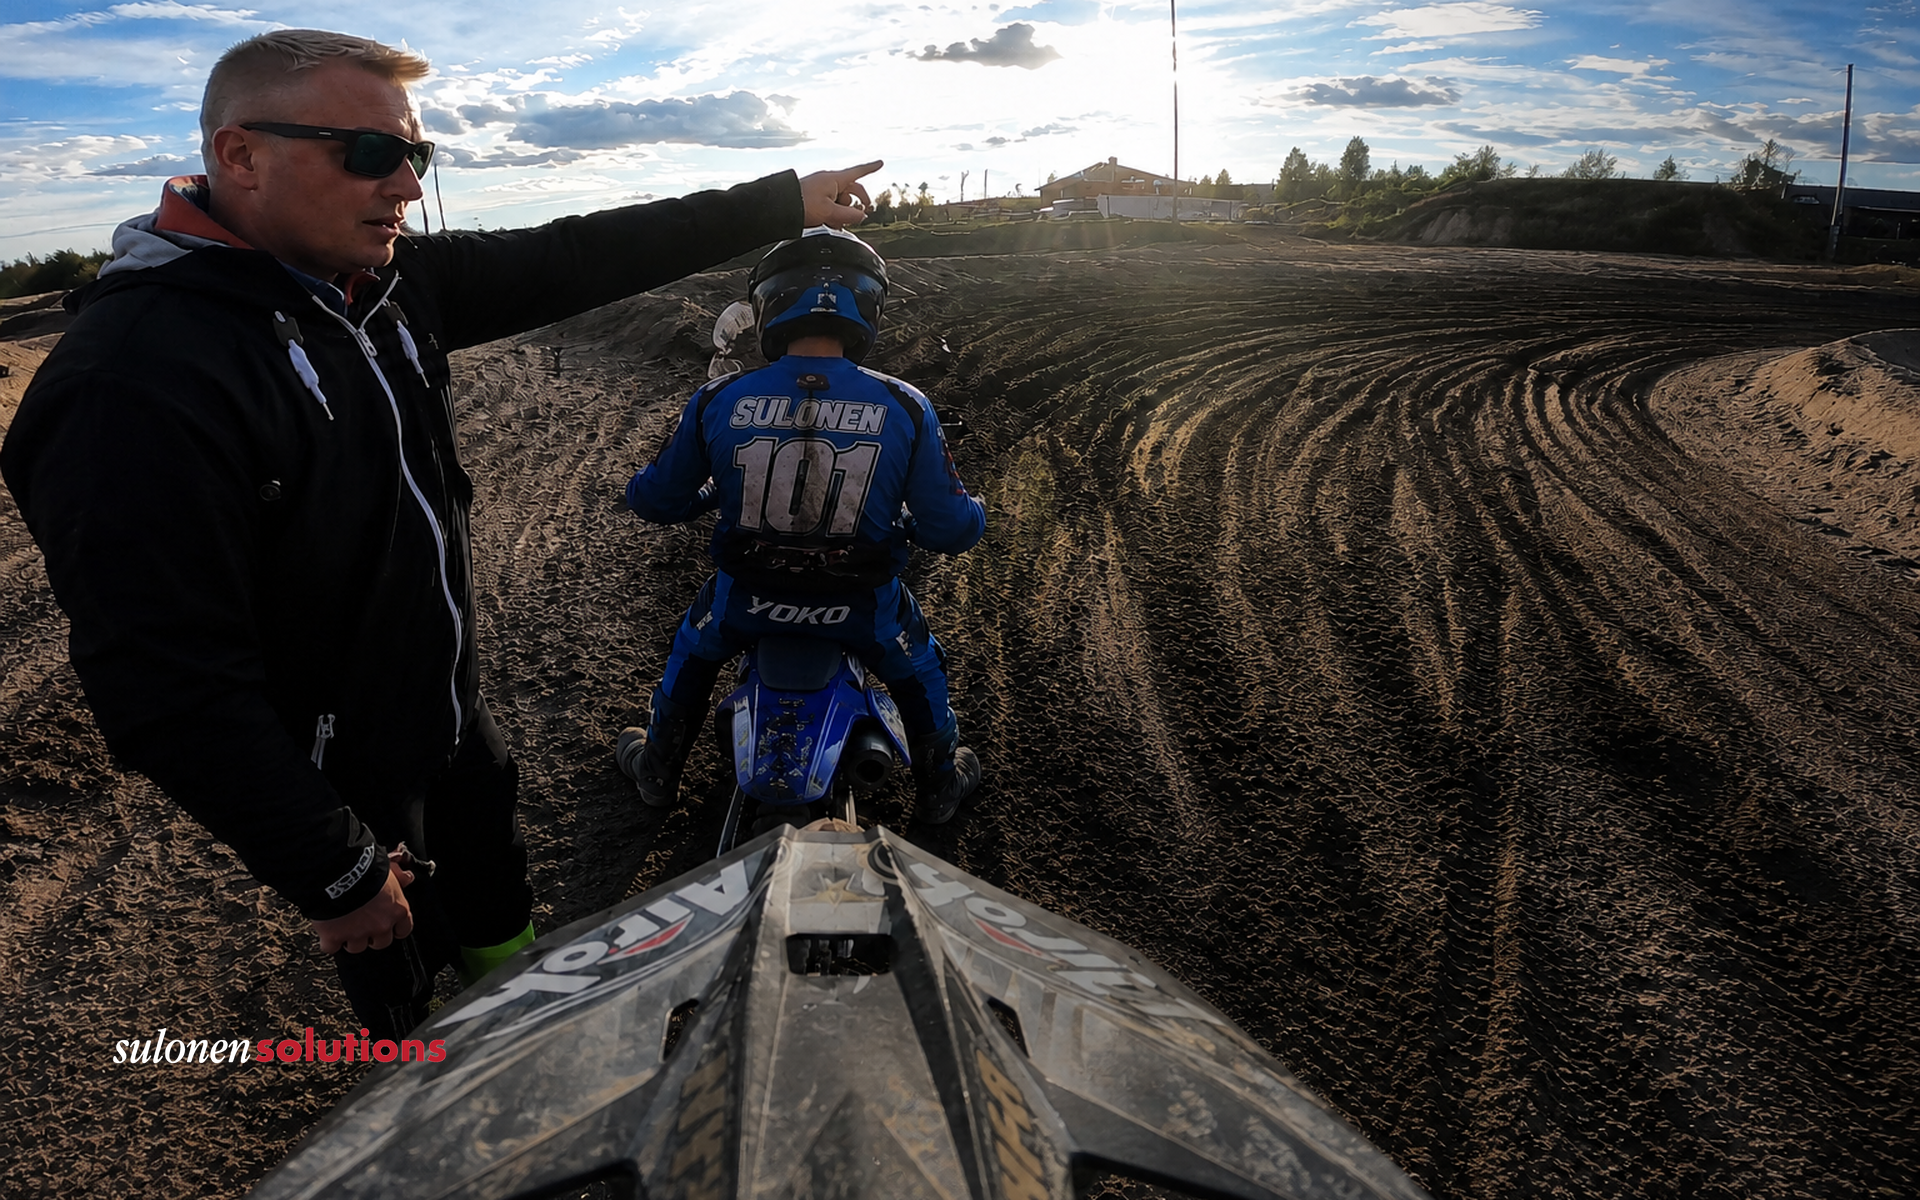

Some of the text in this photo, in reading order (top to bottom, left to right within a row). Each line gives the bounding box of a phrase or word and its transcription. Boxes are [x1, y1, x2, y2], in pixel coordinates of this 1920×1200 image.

[730, 396, 887, 435] SULONEN
[734, 438, 882, 537] 101
[747, 596, 851, 625] YOKO
